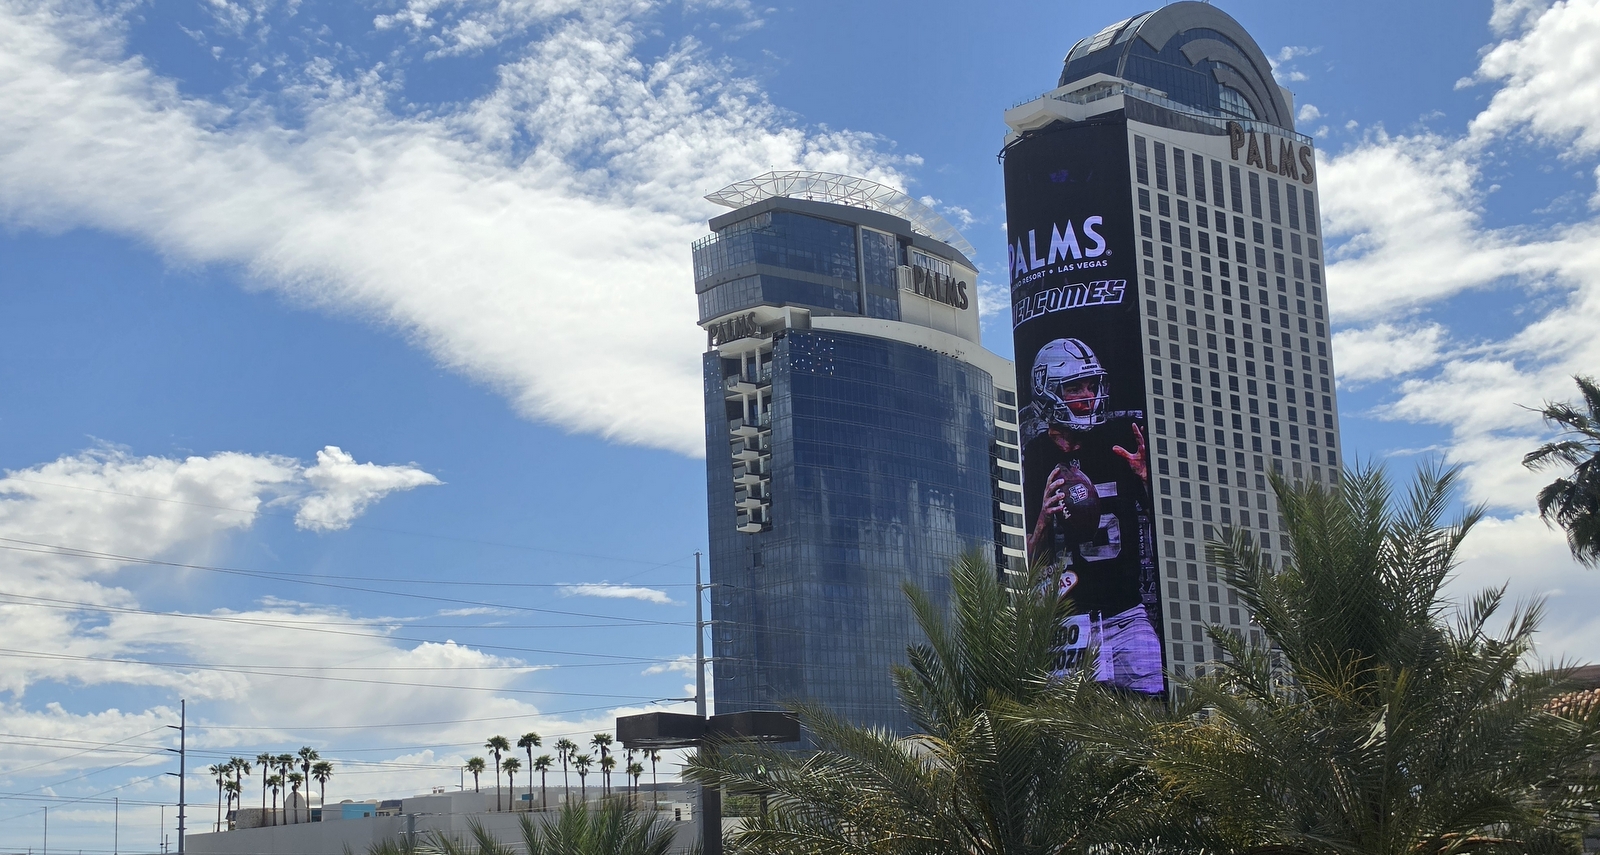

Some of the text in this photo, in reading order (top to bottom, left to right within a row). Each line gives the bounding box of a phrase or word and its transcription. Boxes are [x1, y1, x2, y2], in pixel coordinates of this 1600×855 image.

[1226, 121, 1314, 185] PALMS
[914, 264, 969, 311] PALMS
[1022, 270, 1046, 284] RESORT
[1058, 263, 1075, 273] LAS
[1077, 260, 1108, 269] VEGAS
[708, 311, 756, 346] PALMS
